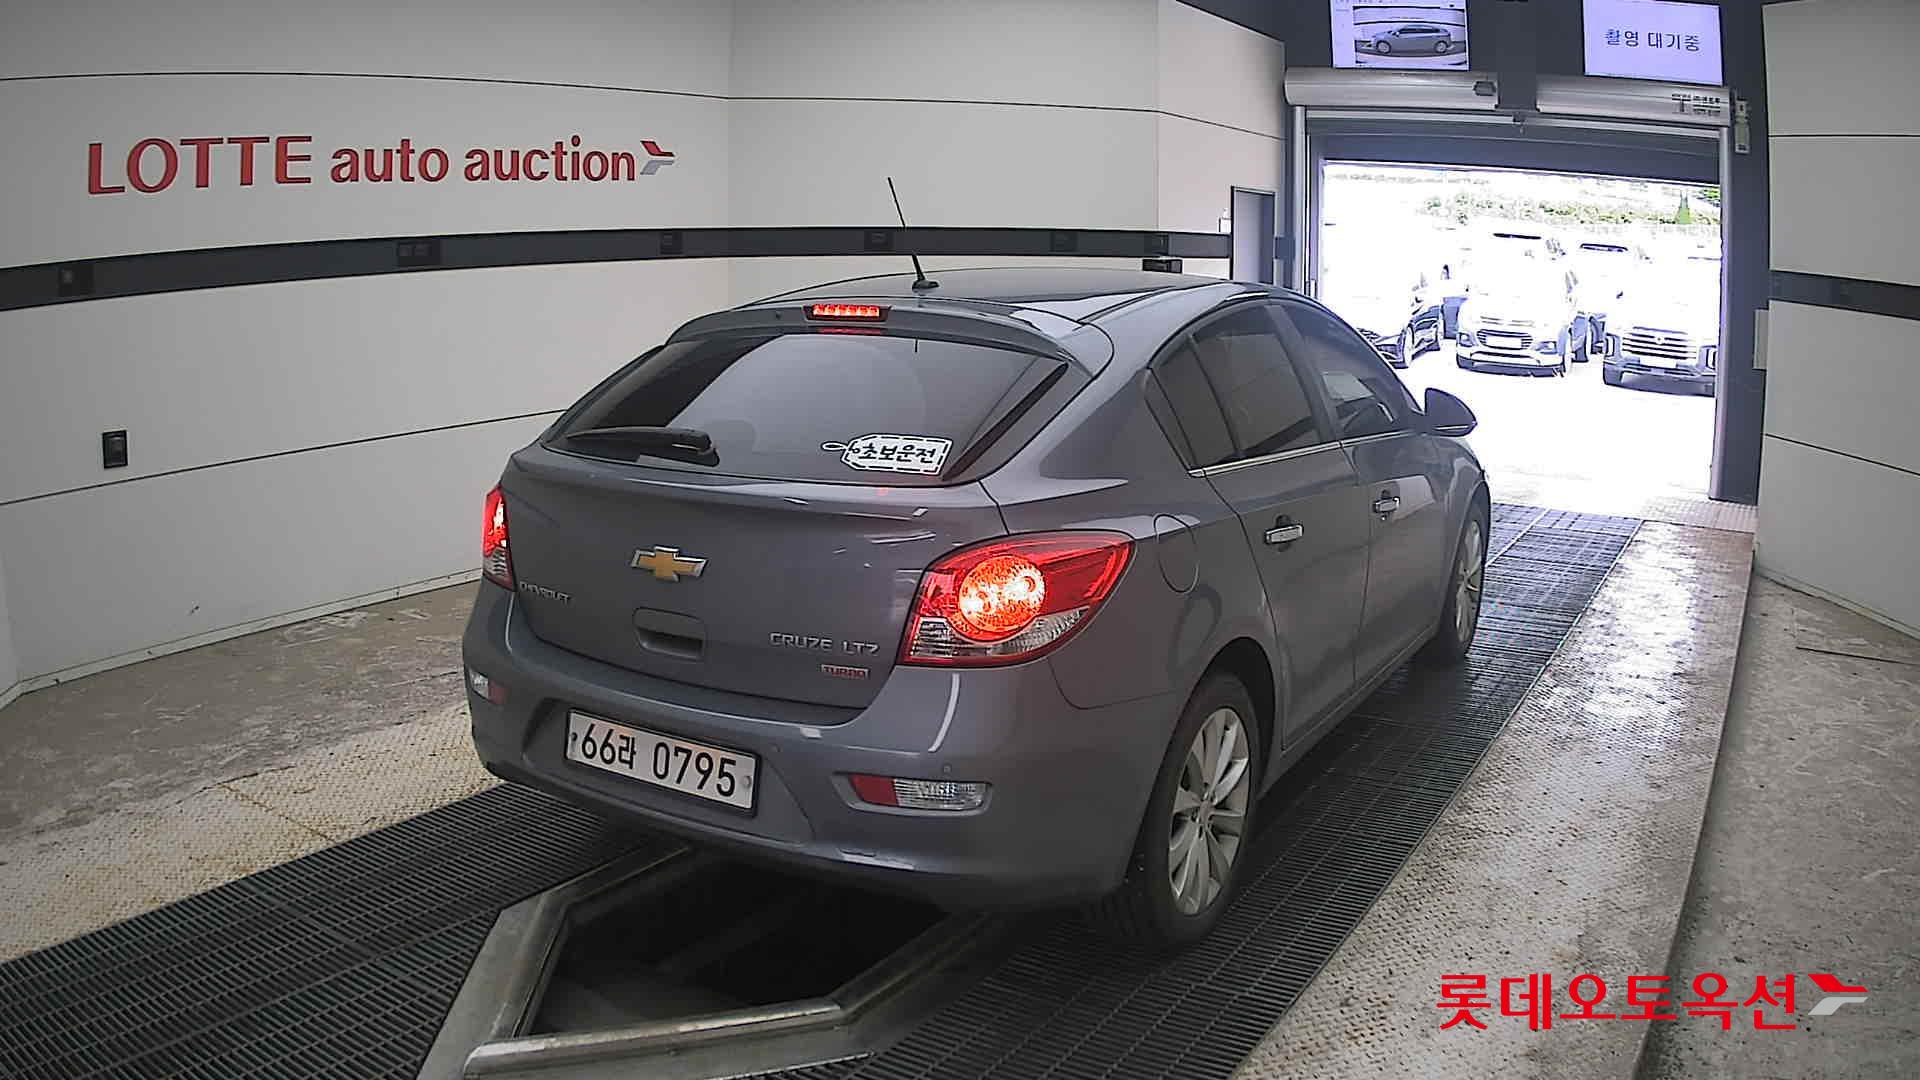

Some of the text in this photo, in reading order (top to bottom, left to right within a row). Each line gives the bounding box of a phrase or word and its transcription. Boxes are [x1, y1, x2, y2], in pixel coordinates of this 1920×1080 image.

[1647, 31, 1700, 52] 대기중
[88, 135, 636, 195] LOTTE auto auction
[857, 442, 937, 464] 초보운전
[769, 632, 880, 657] CRUZE LTZ
[581, 723, 737, 798] 66라 0795
